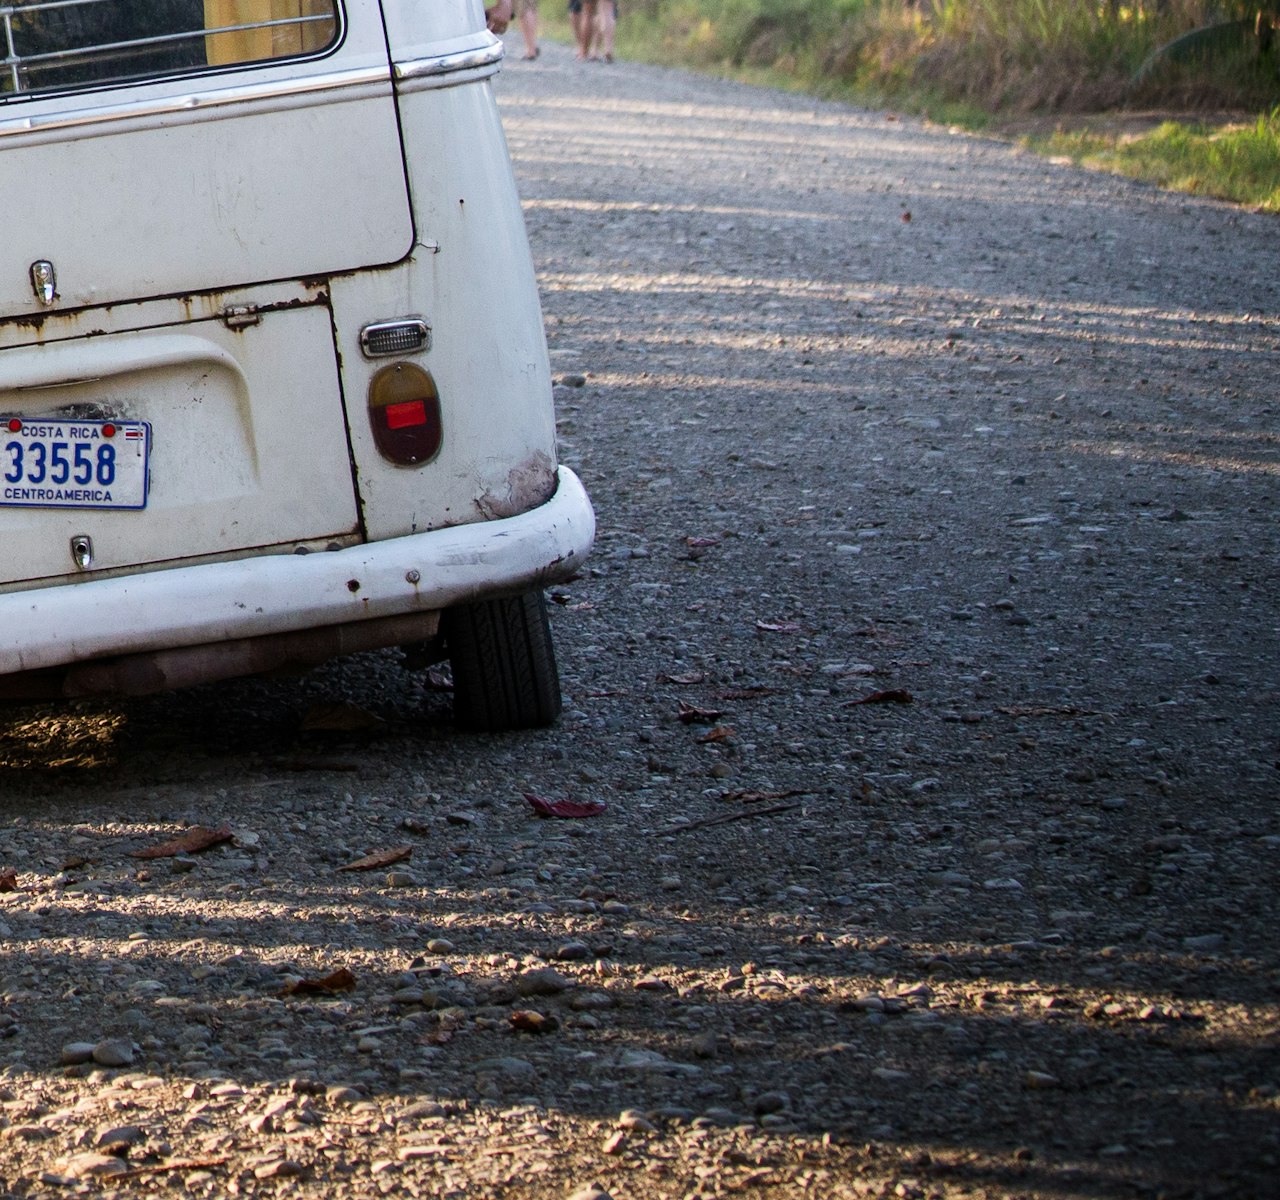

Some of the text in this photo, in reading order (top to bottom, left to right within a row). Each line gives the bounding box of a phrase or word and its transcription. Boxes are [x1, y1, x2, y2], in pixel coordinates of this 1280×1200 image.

[21, 426, 99, 439] COSTA RICA
[4, 441, 116, 486] 33558
[4, 488, 112, 501] CENTROAMERICA
